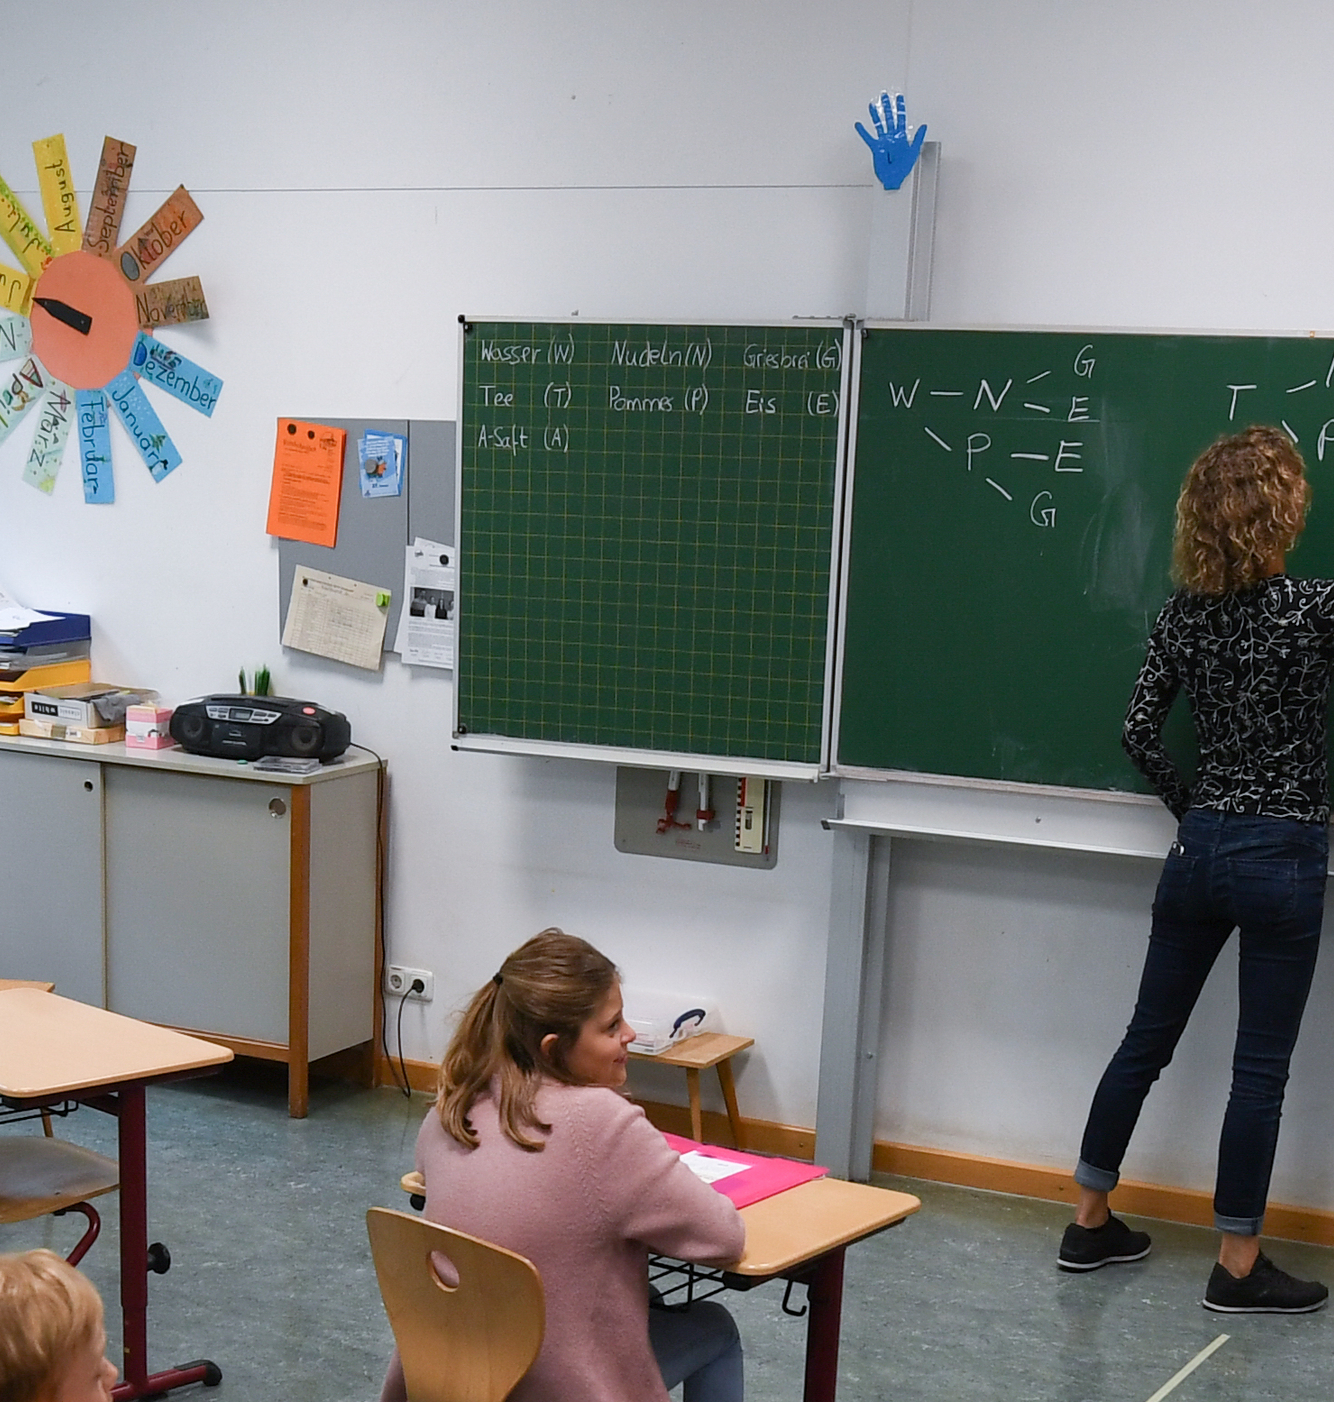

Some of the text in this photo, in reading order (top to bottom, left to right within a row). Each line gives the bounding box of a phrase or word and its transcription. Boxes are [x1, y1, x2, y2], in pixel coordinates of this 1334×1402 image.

[45, 159, 76, 233] August
[121, 211, 187, 281] Oktober
[481, 339, 540, 364] Wasser
[611, 340, 683, 365] Nudeln
[1075, 345, 1095, 378] G
[133, 341, 217, 410] Dezember
[479, 385, 514, 407] Tee
[746, 390, 776, 414] Eis
[890, 379, 1012, 411] W N
[1068, 397, 1089, 422] E
[1227, 385, 1256, 420] T
[112, 386, 159, 460] Januar
[478, 424, 528, 456] A-Saft
[81, 397, 105, 494] Februar
[967, 434, 1083, 472] P E
[1031, 491, 1055, 527] G
